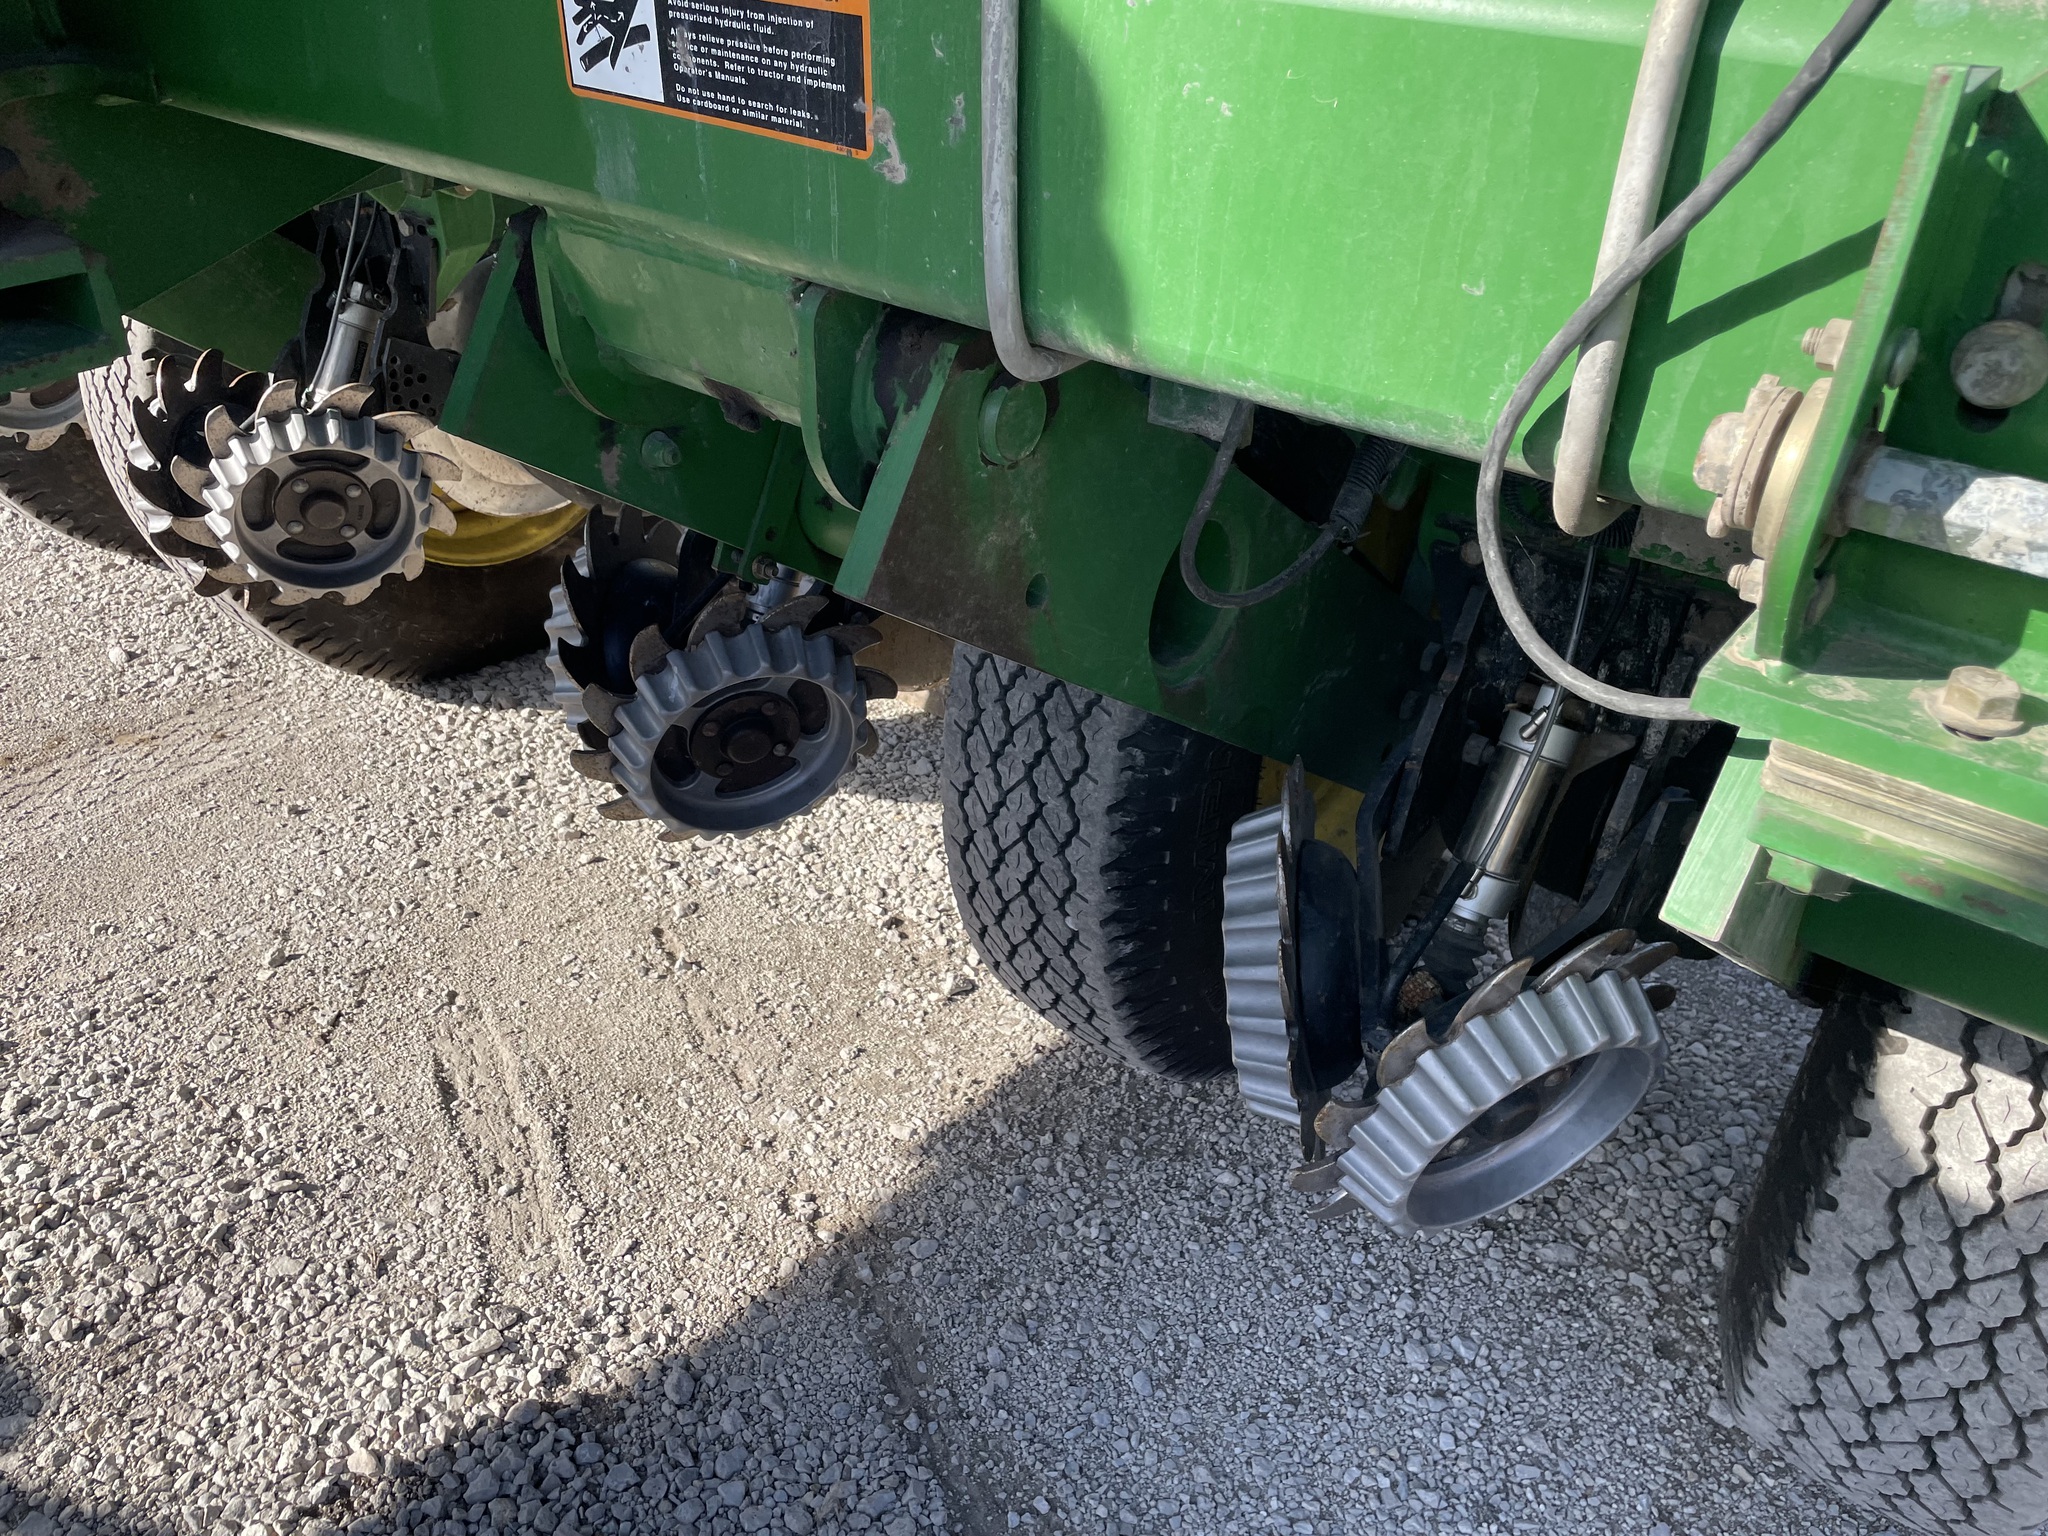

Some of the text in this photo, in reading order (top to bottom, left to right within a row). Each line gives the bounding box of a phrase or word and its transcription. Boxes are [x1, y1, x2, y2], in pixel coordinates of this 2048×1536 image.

[667, 0, 814, 29] Avoid serious injury from injection of
[668, 10, 775, 35] pressurized hydraulic fluid.
[670, 27, 836, 67] Alays relieve pressure before performing
[700, 46, 709, 54] or
[710, 47, 759, 63] maintenance
[761, 57, 771, 66] on
[773, 59, 788, 71] any
[790, 61, 828, 77] hydraulic
[672, 52, 846, 93] coonents. Refer to tractor and implement
[714, 70, 749, 86] Manuals.
[675, 83, 814, 121] Do not use hand to search for leaks.
[676, 93, 806, 130] Use cardboard or similar material.
